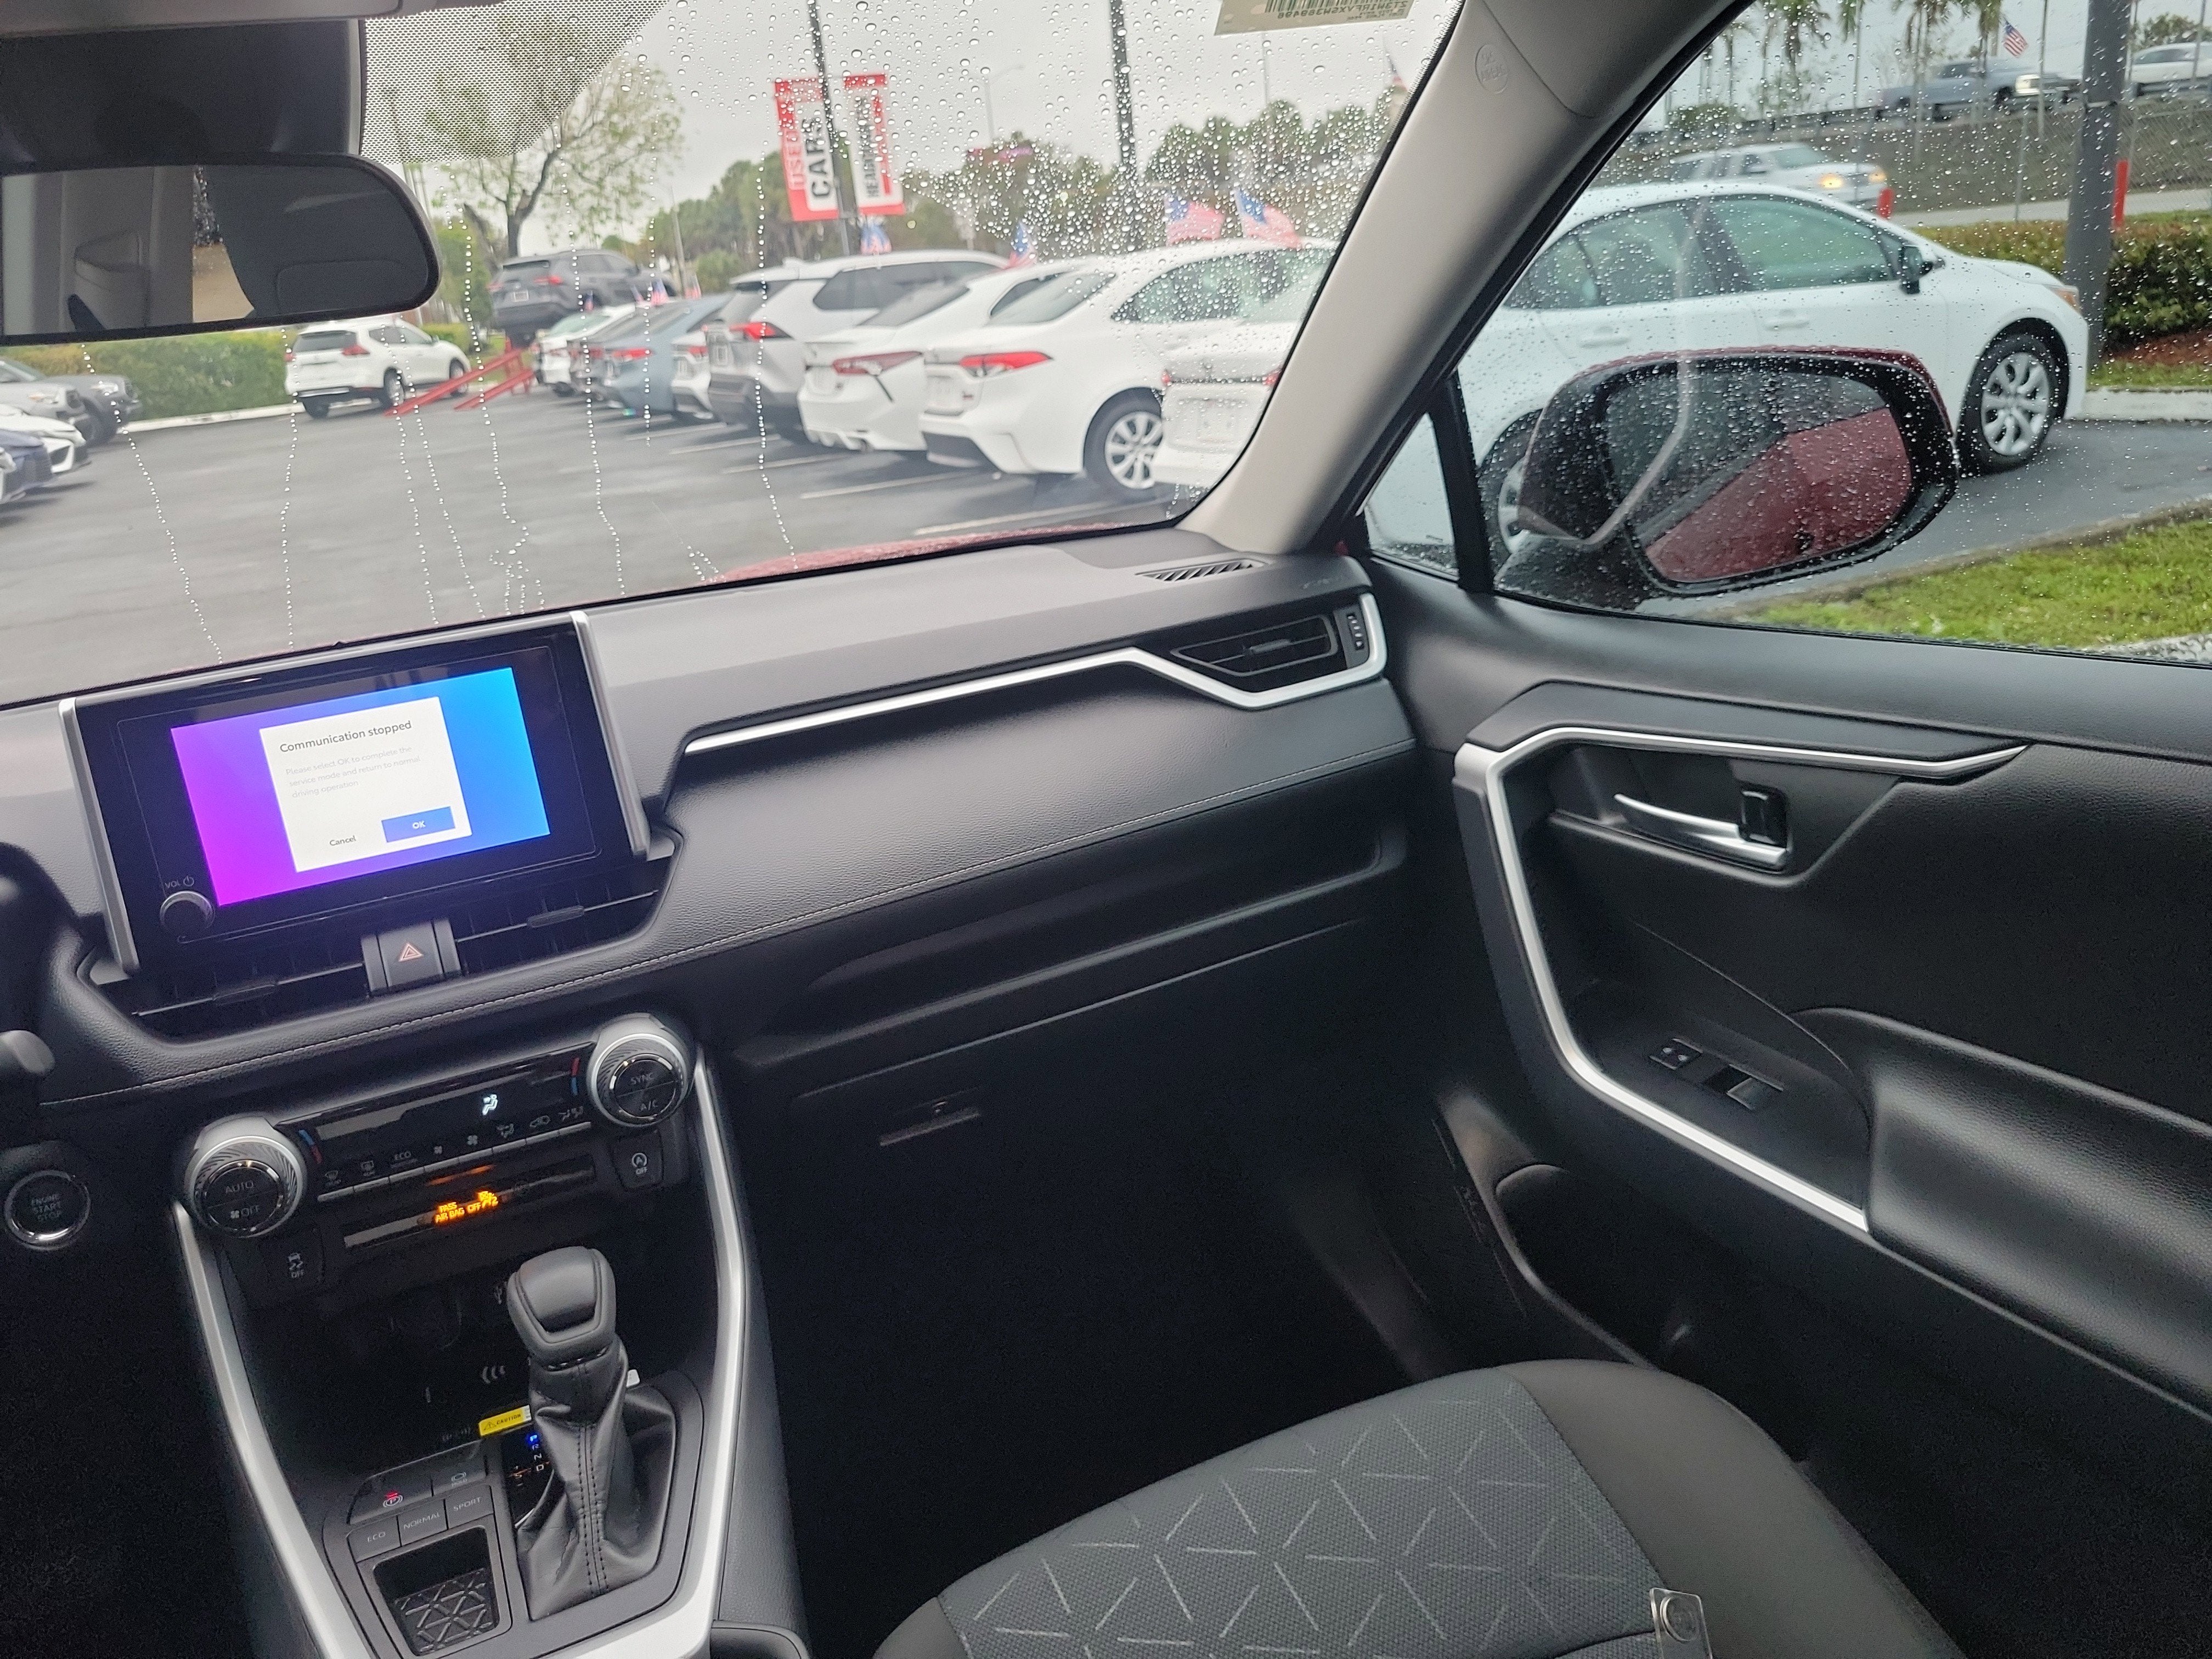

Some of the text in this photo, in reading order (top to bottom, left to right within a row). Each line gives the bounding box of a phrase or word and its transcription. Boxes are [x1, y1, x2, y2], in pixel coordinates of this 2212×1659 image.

[785, 131, 805, 188] USED
[802, 117, 830, 199] CARS
[280, 721, 412, 752] Communication stopped
[286, 766, 312, 775] Please
[313, 761, 337, 769] select
[337, 757, 351, 765] OK
[362, 750, 398, 761] complete
[290, 777, 316, 787] service
[318, 772, 340, 782] mode
[342, 768, 357, 776] and
[358, 764, 382, 773] return
[393, 755, 421, 766] normal
[292, 780, 359, 798] driving operation
[411, 820, 426, 830] OK
[329, 836, 357, 847] Cancel
[165, 879, 180, 888] VOL
[630, 1071, 654, 1084] SYNC
[640, 1099, 658, 1111] A/C
[394, 1150, 411, 1160] ECO
[225, 1180, 253, 1193] AUTO
[435, 1202, 482, 1223] AIR BAG OFF
[439, 1202, 458, 1212] PASS
[496, 1413, 521, 1425] CAUTION
[453, 1497, 482, 1511] SPORT
[403, 1512, 440, 1530] NORMAL
[367, 1532, 386, 1543] ECO
